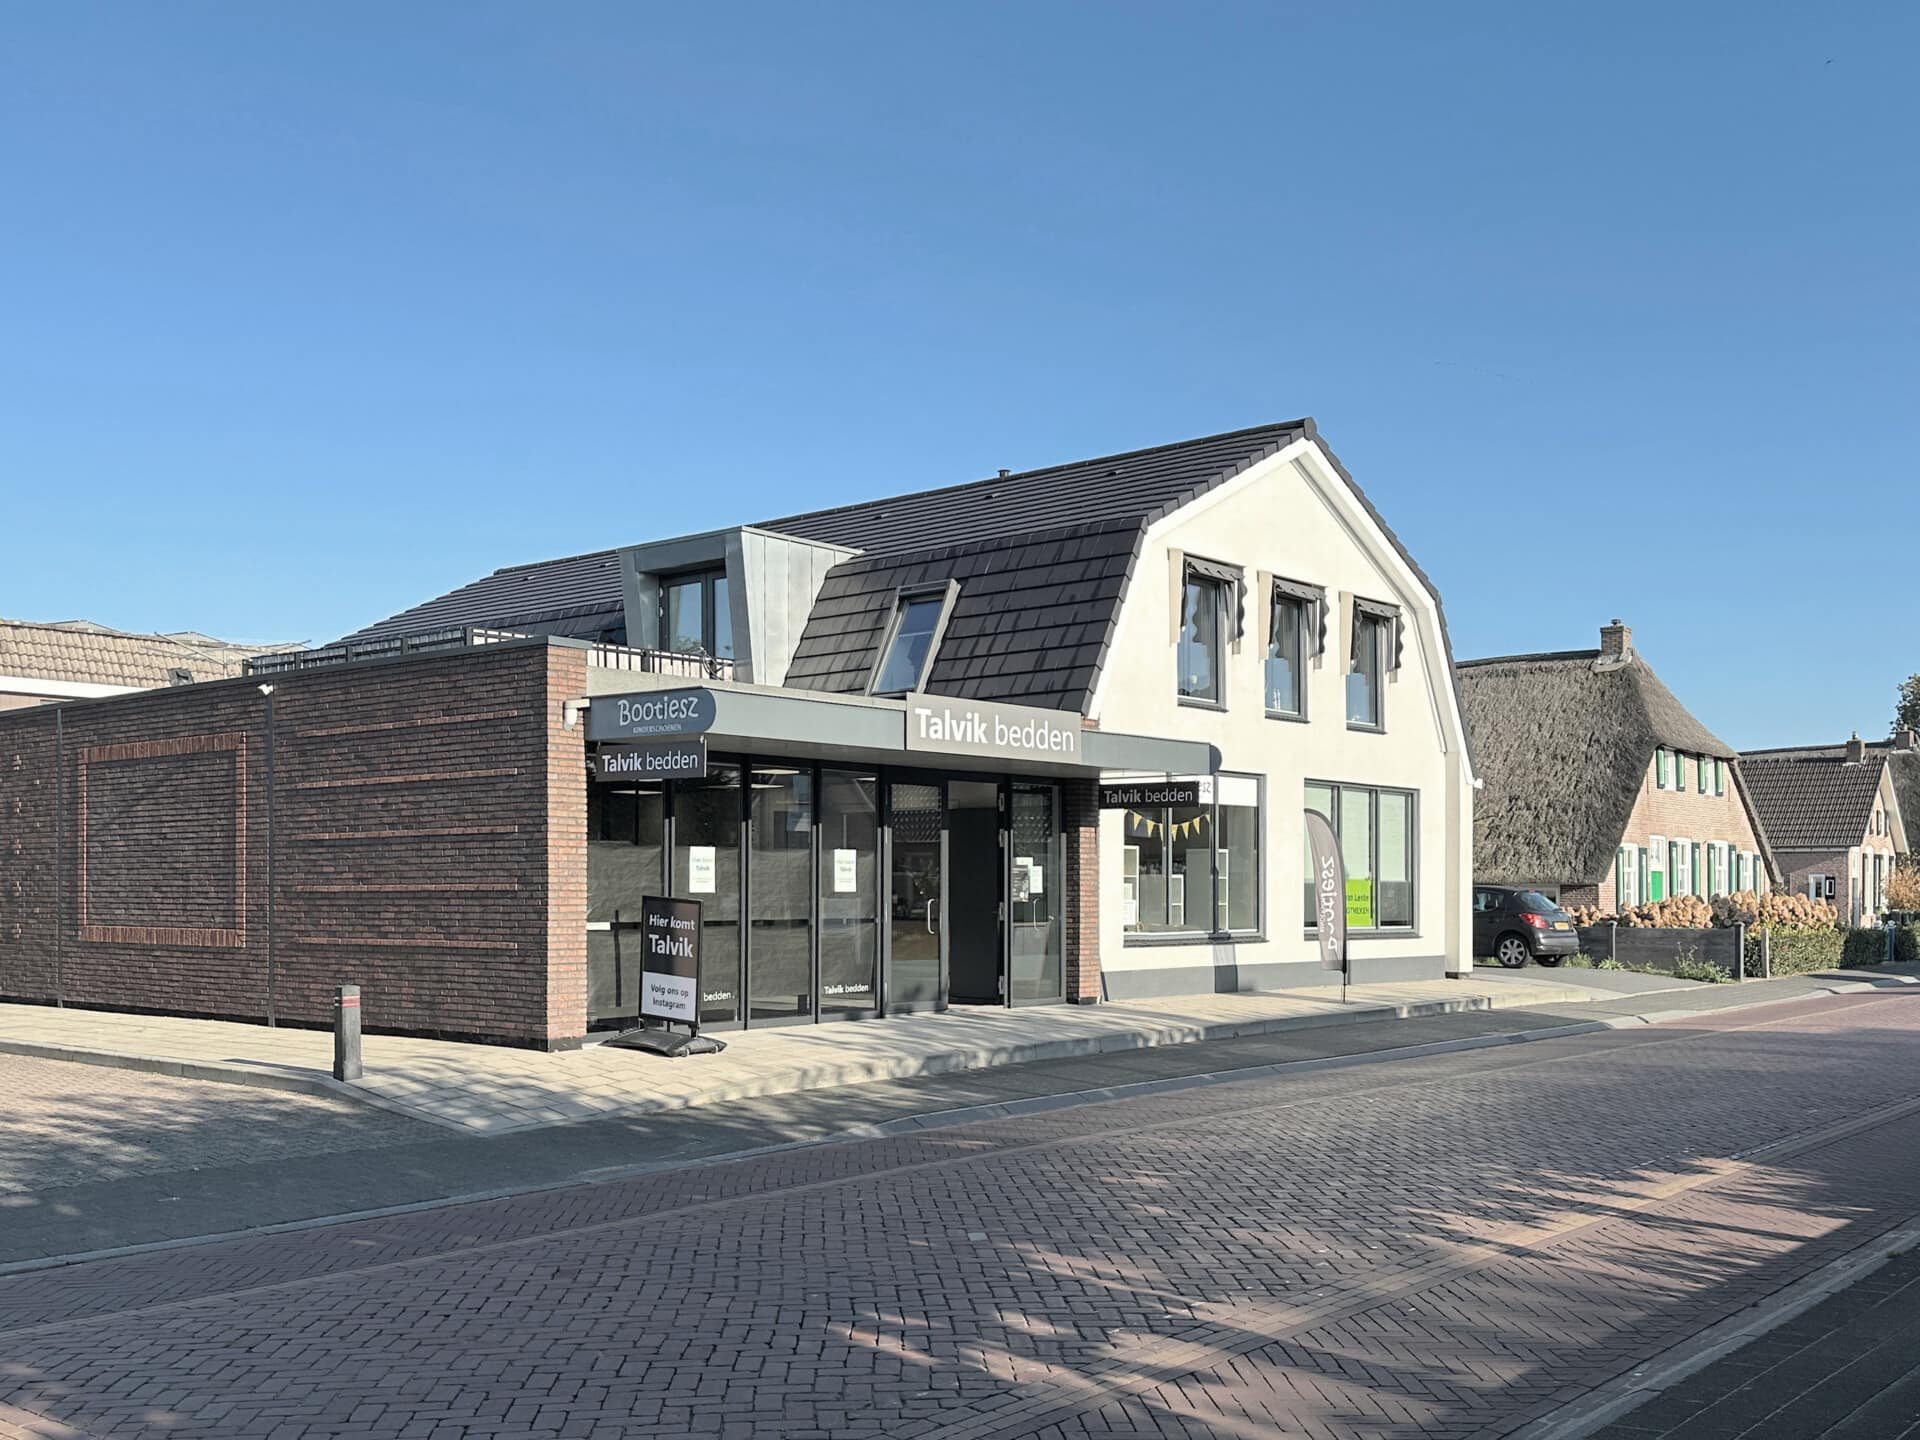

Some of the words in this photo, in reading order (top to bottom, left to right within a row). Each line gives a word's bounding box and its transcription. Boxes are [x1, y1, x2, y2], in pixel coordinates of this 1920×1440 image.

[617, 696, 699, 727] Bootiesz
[915, 708, 988, 744] Talvik
[995, 714, 1074, 752] bedden
[602, 752, 642, 773] Talvik
[646, 750, 698, 770] bedden
[1104, 789, 1141, 804] Talvik
[1145, 788, 1193, 803] bedden
[649, 914, 668, 927] Hier
[670, 916, 695, 931] komt
[649, 934, 694, 958] Talvik
[651, 983, 665, 996] Volg
[667, 987, 679, 995] ons
[681, 989, 689, 998] op
[653, 997, 686, 1010] Instagram
